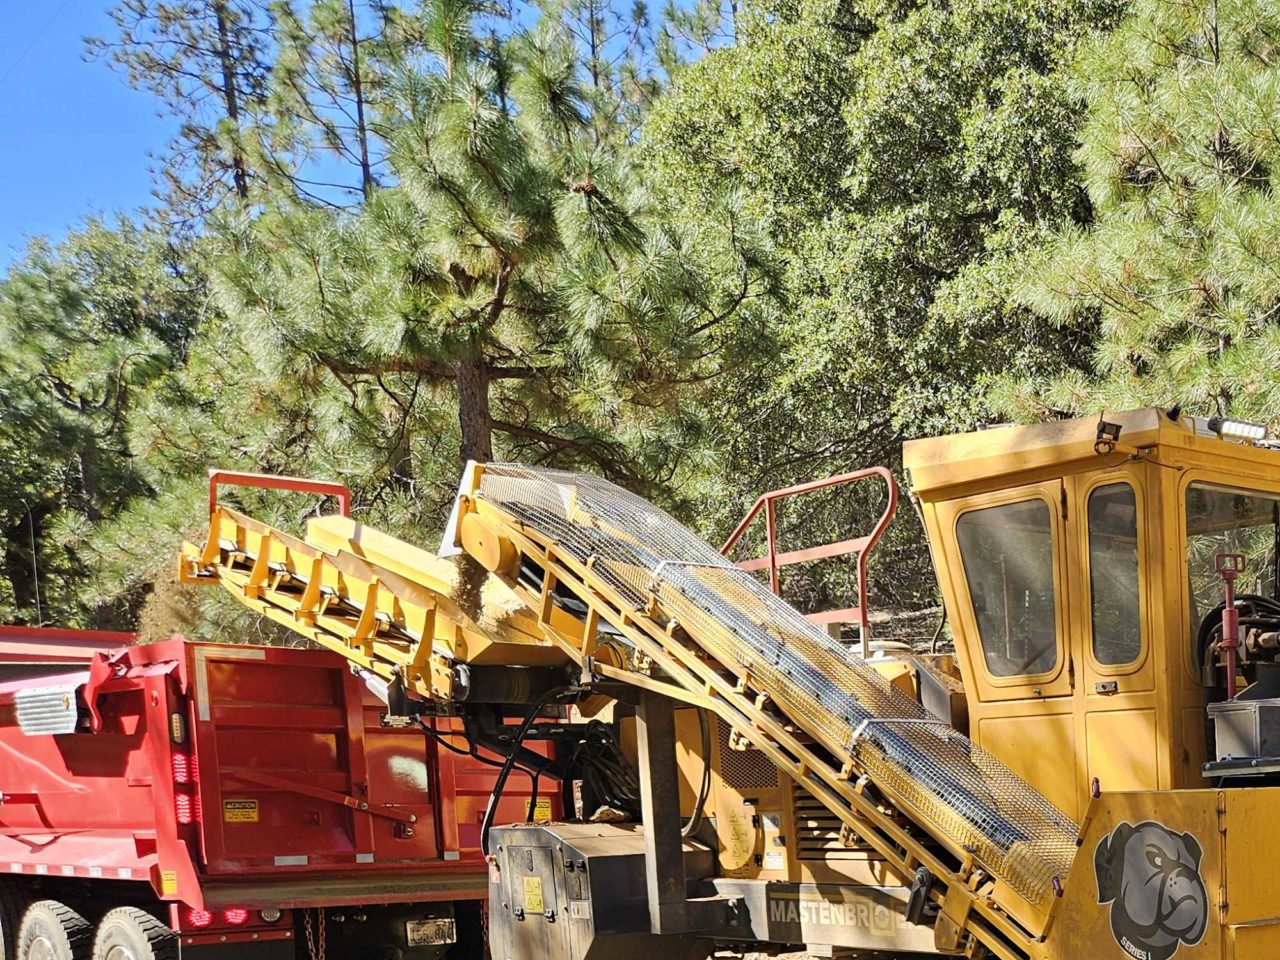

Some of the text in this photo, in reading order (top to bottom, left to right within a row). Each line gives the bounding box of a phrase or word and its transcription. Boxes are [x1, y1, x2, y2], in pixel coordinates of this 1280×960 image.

[770, 899, 914, 929] MASTENBROE
[1120, 936, 1152, 960] SERIES I
